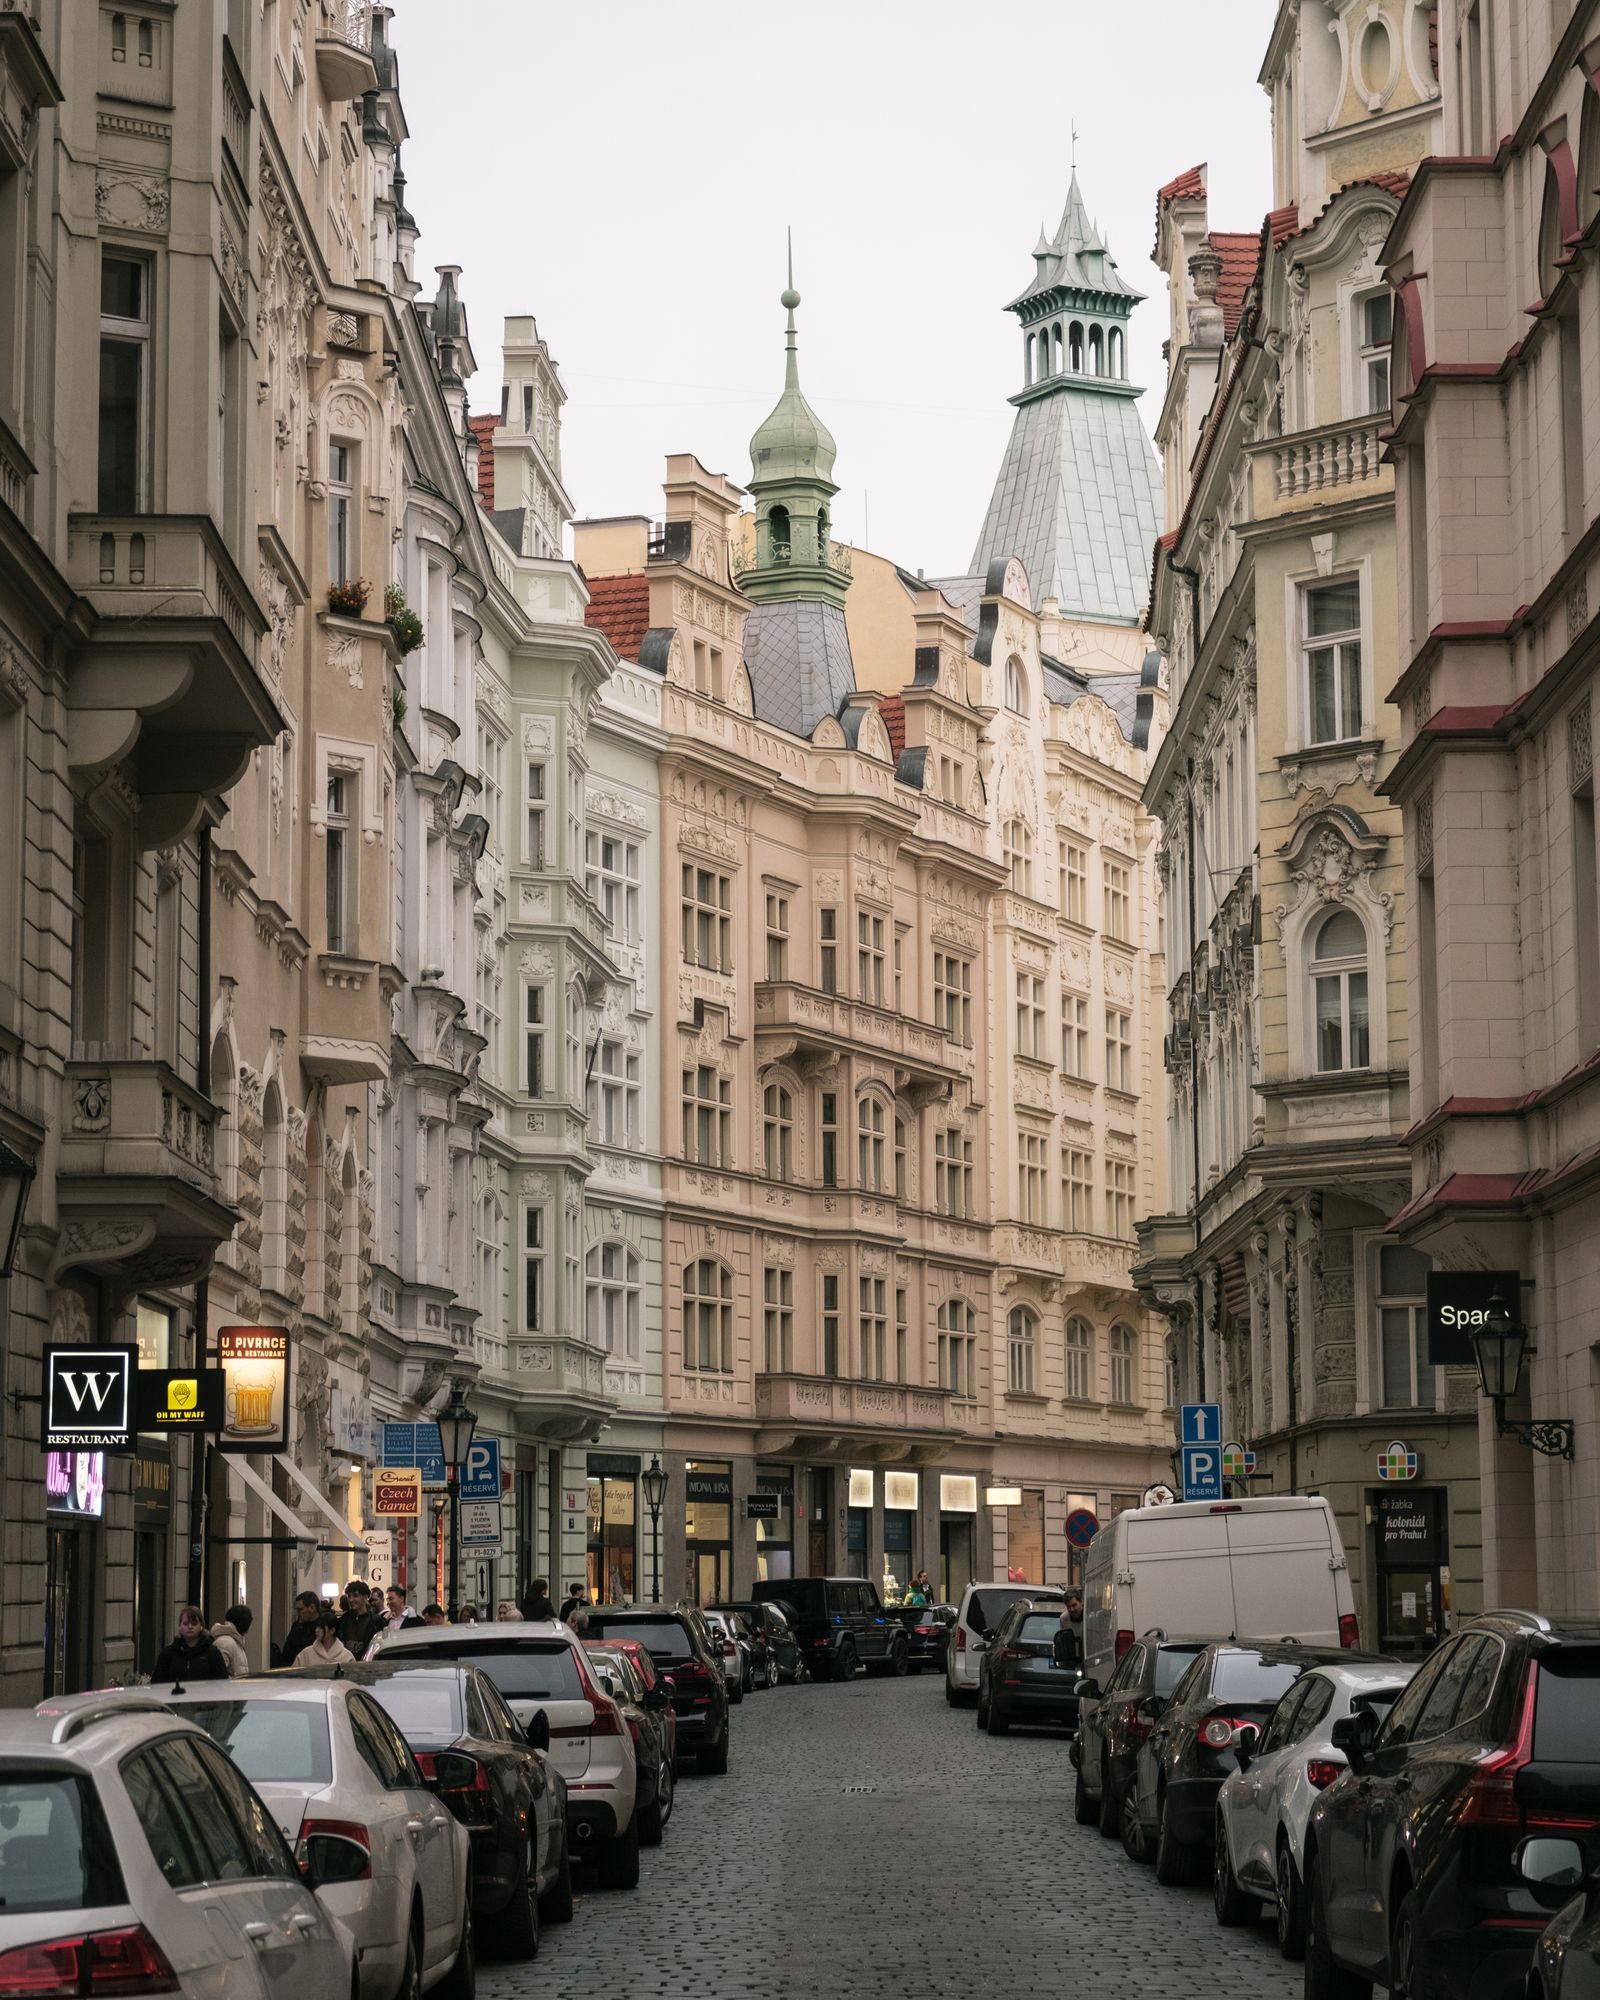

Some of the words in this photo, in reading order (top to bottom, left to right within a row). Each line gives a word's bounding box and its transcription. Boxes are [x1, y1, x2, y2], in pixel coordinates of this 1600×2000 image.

[221, 1337, 230, 1348] U
[235, 1337, 286, 1348] PIVRNCE
[57, 1371, 121, 1412] W
[169, 1411, 182, 1419] MY
[184, 1411, 205, 1419] WAFF
[47, 1435, 129, 1444] RESTAURANT
[467, 1447, 490, 1481] P
[1190, 1452, 1213, 1485] P
[380, 1487, 414, 1499] Czech
[462, 1483, 497, 1493] RÉSERVÉ
[688, 1482, 712, 1494] MONA
[714, 1482, 730, 1494] LISA
[1186, 1487, 1219, 1496] RÉSERVÉ
[377, 1500, 416, 1512] Garnet
[1386, 1514, 1426, 1528] koloniál
[1385, 1531, 1398, 1542] pro
[1398, 1529, 1422, 1539] Prahu
